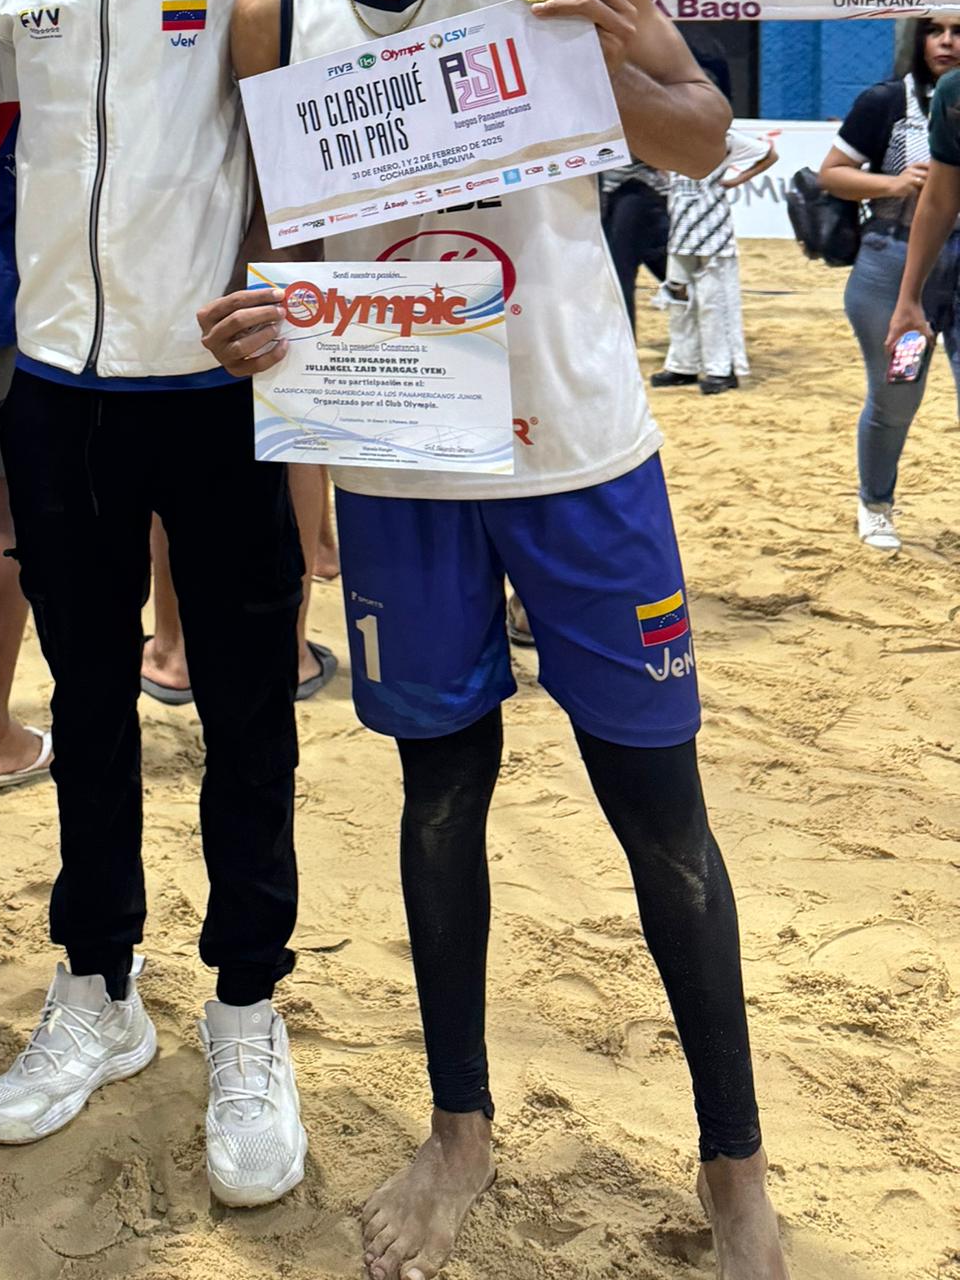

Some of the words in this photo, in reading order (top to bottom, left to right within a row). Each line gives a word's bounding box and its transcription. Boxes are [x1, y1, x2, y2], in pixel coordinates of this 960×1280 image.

[20, 7, 60, 28] FVV
[444, 27, 468, 43] CSV
[380, 41, 427, 62] Olympic
[327, 62, 353, 77] FIVB
[296, 100, 321, 135] YO
[324, 62, 427, 126] CLASIFIQUÉ
[319, 137, 334, 171] A
[336, 131, 362, 167] MI
[366, 111, 410, 156] PAÍS
[352, 172, 361, 180] 31
[361, 169, 373, 178] DE
[406, 158, 413, 166] Y
[413, 157, 419, 165] 2
[420, 153, 431, 163] DE
[431, 144, 468, 160] FEBRERO
[469, 141, 481, 151] DE
[481, 135, 504, 148] 2025
[442, 151, 476, 167] BOLIVIA
[283, 280, 468, 338] Olympic
[315, 341, 340, 354] Otorga
[340, 341, 348, 352] la
[349, 343, 380, 354] presente
[380, 342, 420, 353] Constancia
[329, 356, 356, 364] MEJOR
[357, 356, 397, 365] JUGADOR
[399, 357, 420, 365] MVP
[305, 364, 352, 373] JULIANGEL
[354, 364, 378, 373] ZAID
[379, 365, 419, 374] VARGAS
[419, 367, 447, 376] (VEN)
[323, 377, 336, 386] Por
[348, 377, 402, 388] participación
[273, 386, 324, 395] CLASIFICATORIO
[324, 389, 376, 397] SUDAMERICANO
[383, 390, 397, 398] LOS
[398, 391, 456, 400] PANAMERICANOS
[313, 397, 360, 407] Organizado
[360, 400, 375, 409] por
[375, 399, 384, 407] el
[385, 399, 402, 408] Club
[355, 614, 382, 683] 1
